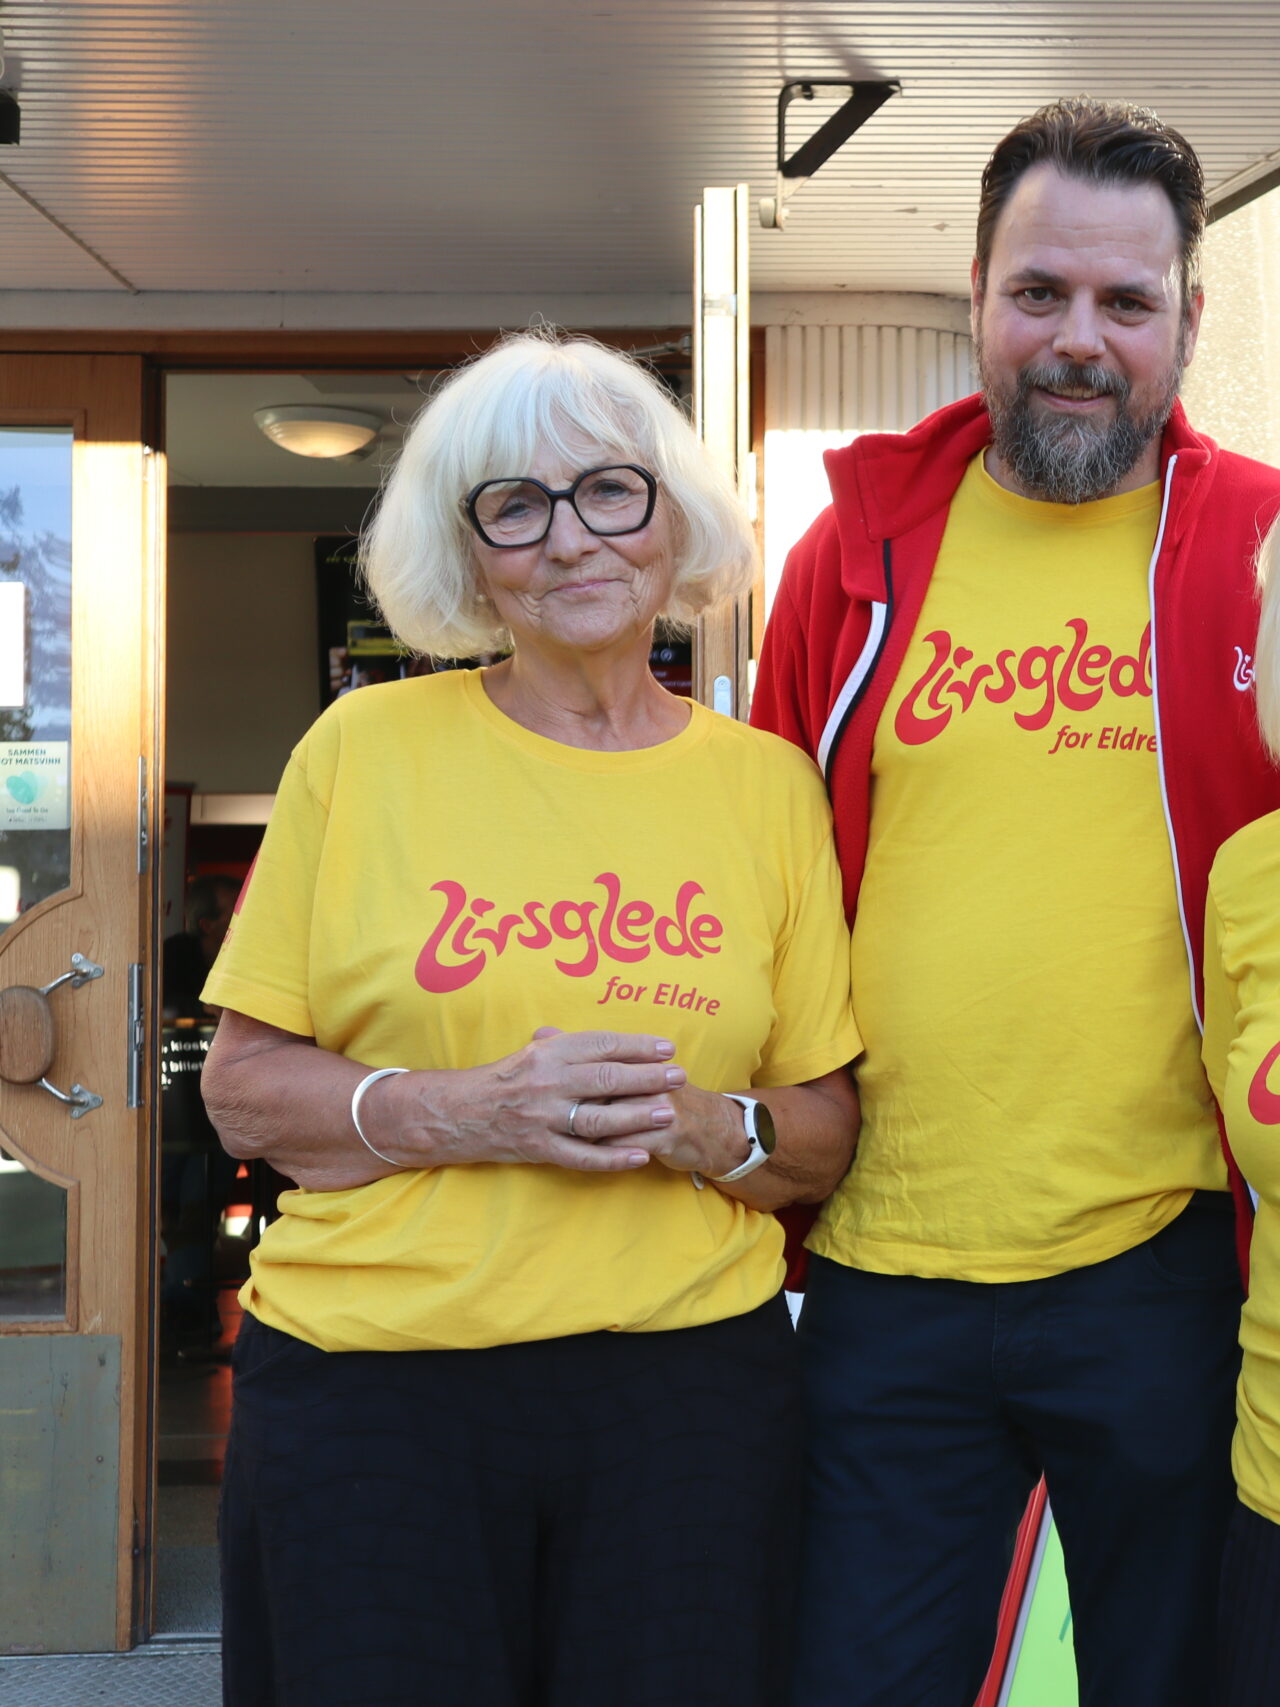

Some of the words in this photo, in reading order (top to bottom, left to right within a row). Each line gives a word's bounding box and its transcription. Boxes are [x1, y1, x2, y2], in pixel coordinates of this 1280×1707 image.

[895, 618, 1153, 746] Livsgled
[8, 748, 46, 757] SAMMEN
[1048, 724, 1092, 754] for
[0, 757, 13, 766] OT
[414, 871, 723, 994] Livsglede
[597, 976, 647, 1005] for
[652, 983, 721, 1016] Eldre
